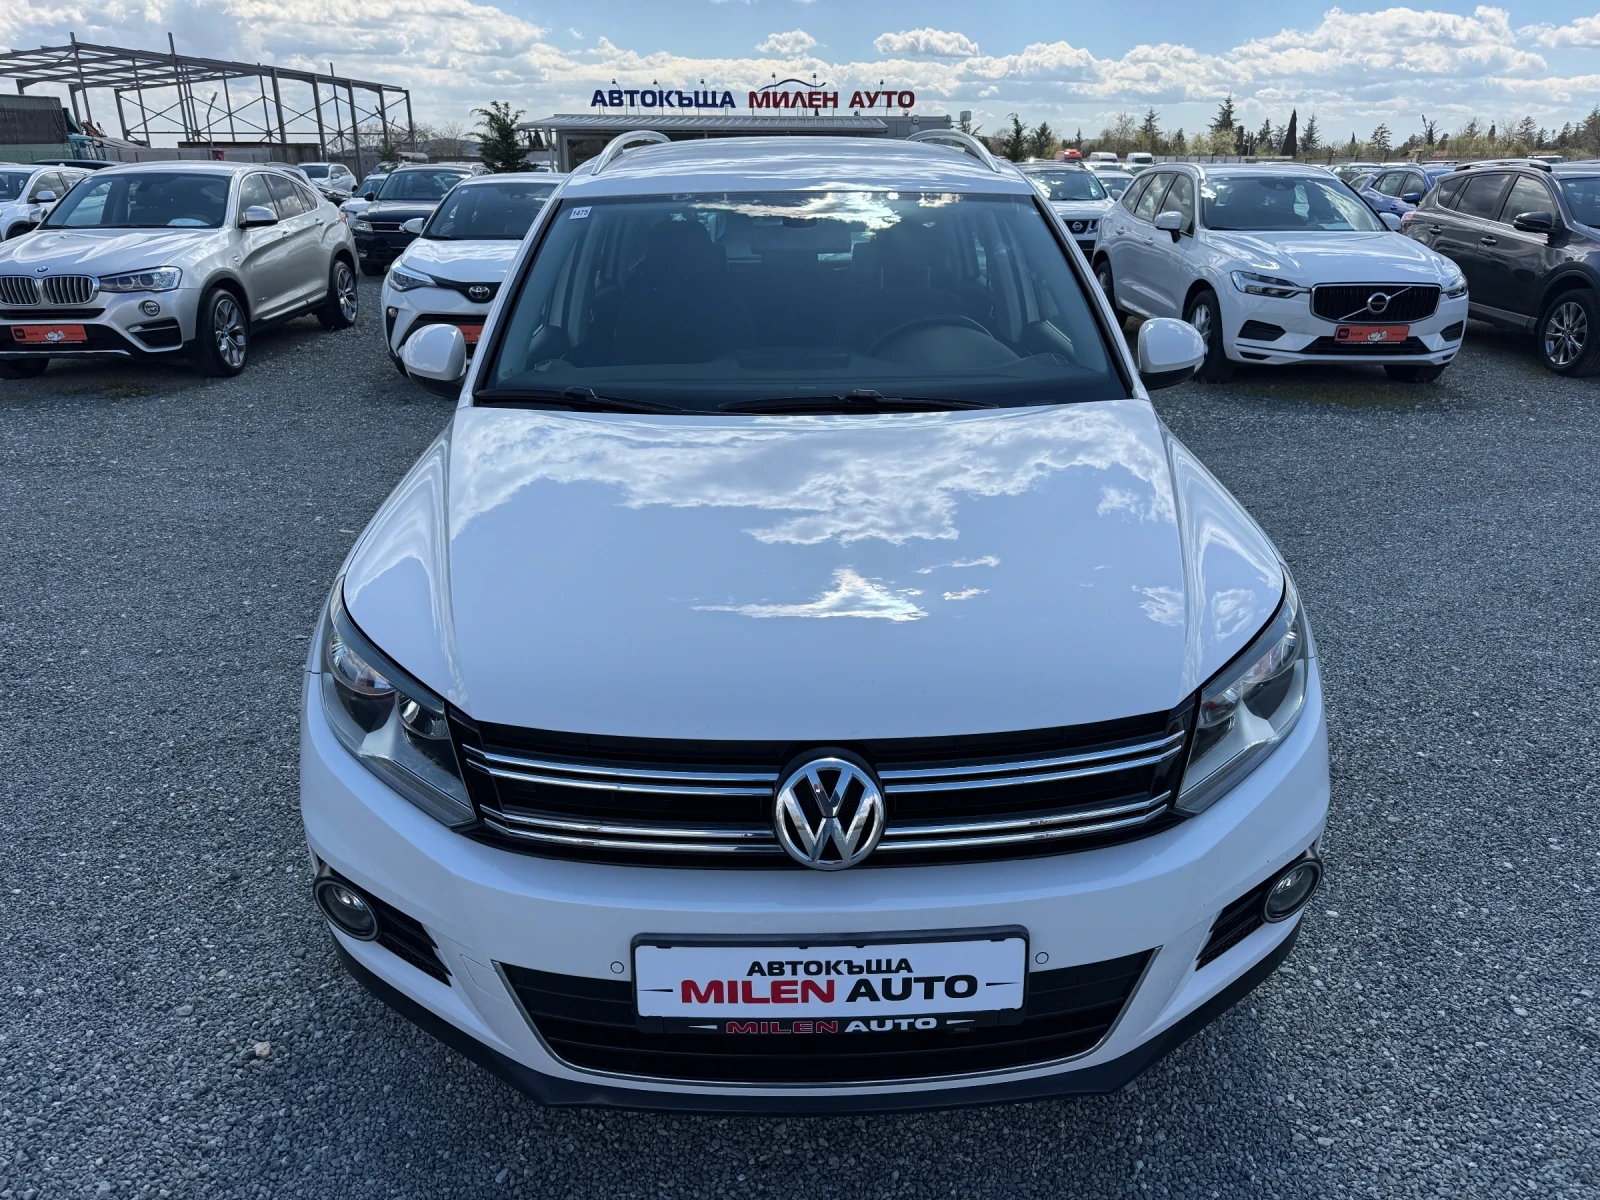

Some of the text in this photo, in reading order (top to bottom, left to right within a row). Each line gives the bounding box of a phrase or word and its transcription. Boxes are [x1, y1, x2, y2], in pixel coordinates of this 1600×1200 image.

[591, 90, 915, 109] АВТОКЪЩА МИЛЕН АУТО
[572, 209, 588, 217] 1475
[746, 958, 914, 976] АВТОКЪЩА
[681, 974, 978, 1004] MILEN AUTO
[726, 1017, 937, 1034] MILEN AUTO
